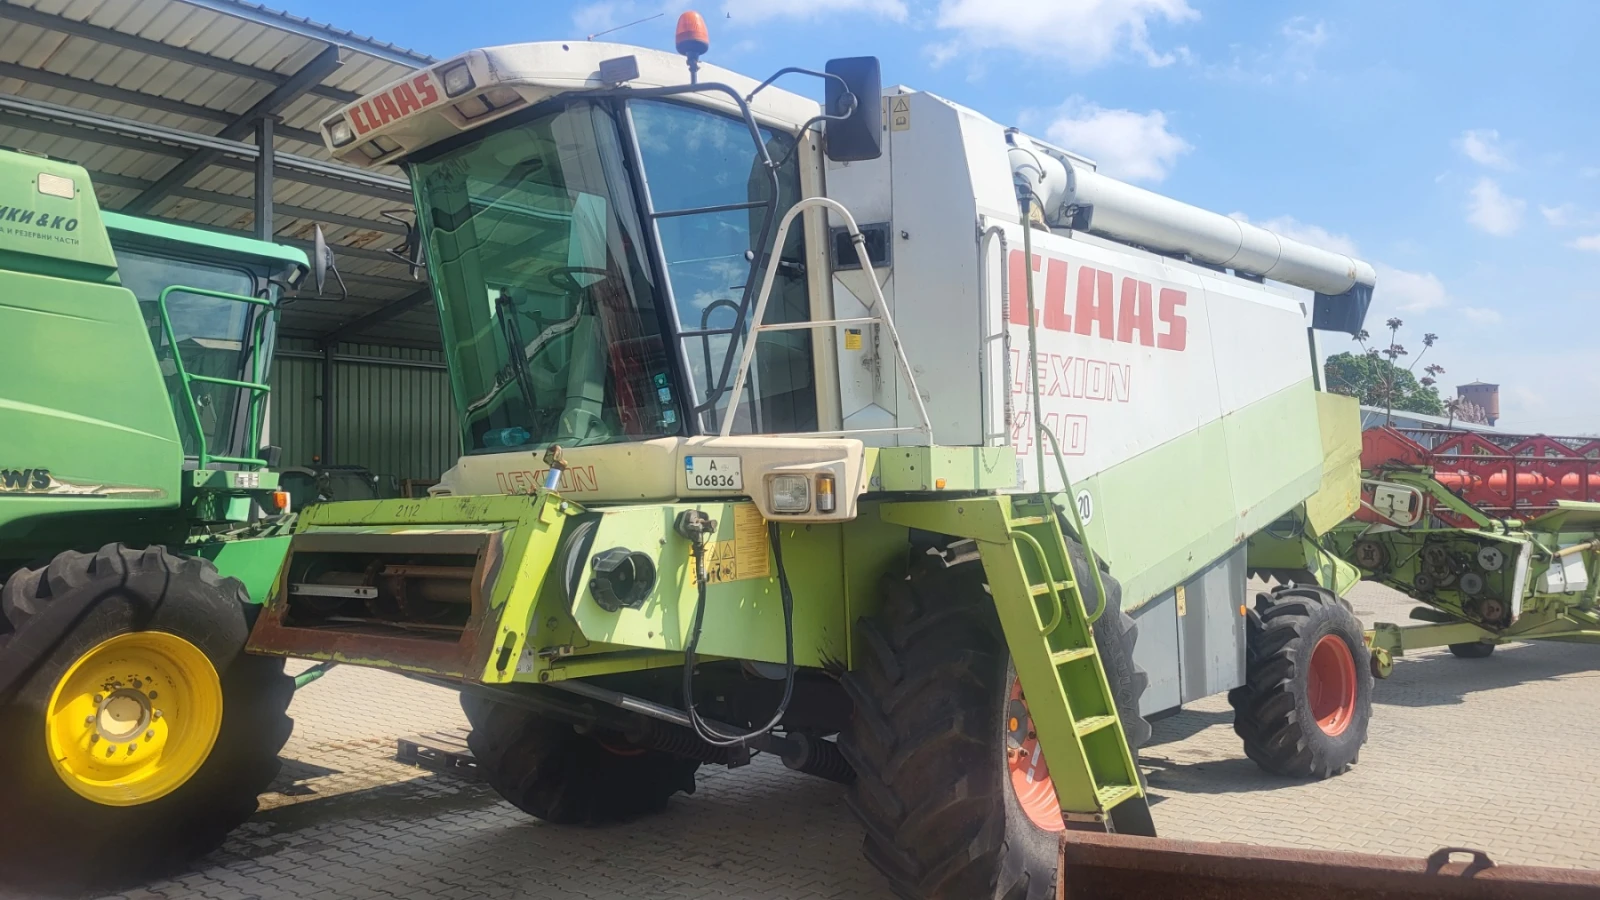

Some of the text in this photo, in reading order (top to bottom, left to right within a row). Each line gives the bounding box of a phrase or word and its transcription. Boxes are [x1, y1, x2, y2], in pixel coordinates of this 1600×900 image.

[348, 72, 438, 135] CLAAS
[15, 229, 52, 241] РЕЗЕРВНИ
[54, 236, 80, 245] ЧАСТИ
[1008, 248, 1187, 352] CLAAS
[1008, 348, 1131, 403] LEXION
[1010, 411, 1088, 456] 440
[709, 459, 718, 471] A
[695, 475, 734, 487] 06836
[395, 504, 421, 518] 2112
[1077, 494, 1090, 520] 20
